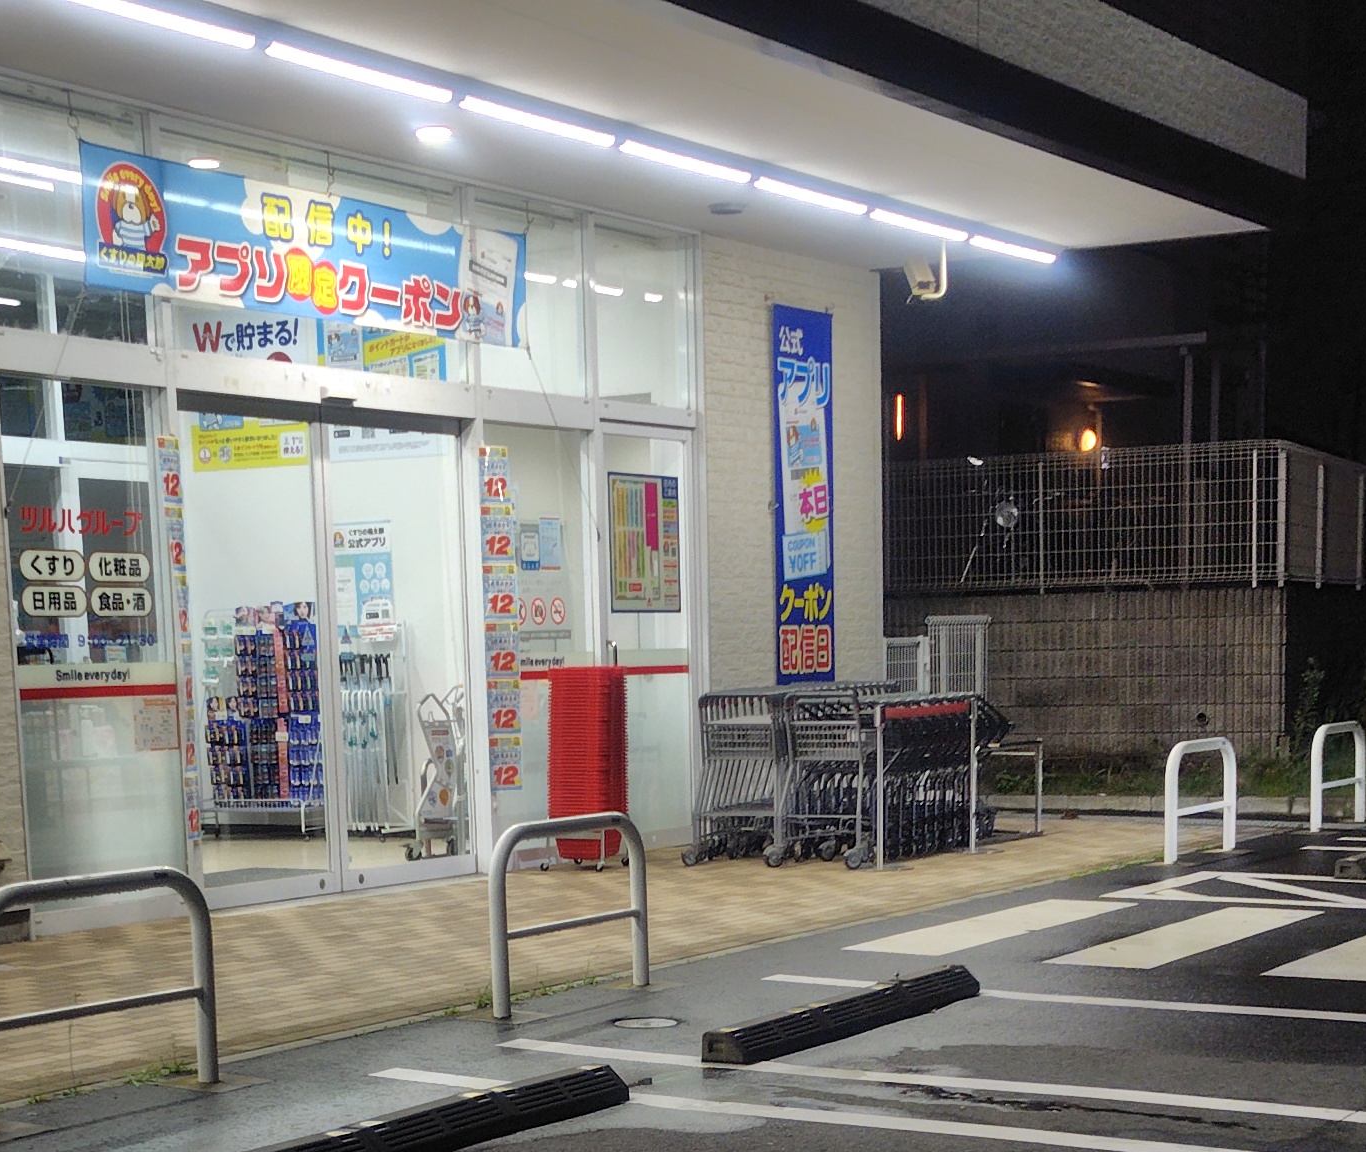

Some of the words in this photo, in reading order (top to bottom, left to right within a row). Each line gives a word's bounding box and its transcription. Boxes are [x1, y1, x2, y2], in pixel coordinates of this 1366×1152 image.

[261, 192, 392, 259] 配信中!
[100, 246, 166, 271] くすりの福太郎
[174, 234, 464, 331] アプリ限定クーポン
[192, 318, 299, 352] Wで貯まる!
[778, 325, 804, 357] 公式
[778, 357, 831, 408] アプリ
[163, 472, 180, 497] 12
[484, 477, 507, 497] 12
[799, 484, 828, 519] 本日
[21, 506, 143, 537] ツルハグループ
[348, 537, 386, 549] 公式アプリ
[486, 535, 511, 556] 12
[787, 536, 815, 551] COUPON
[31, 555, 75, 576] くすり
[98, 557, 142, 578] 化粧品
[32, 591, 77, 611] 日用品
[98, 592, 146, 612] 食品・酒
[488, 594, 514, 614] 12
[780, 582, 832, 623] クーポン
[779, 624, 832, 674] 配信日
[490, 651, 516, 672] 12
[56, 670, 83, 682] Smile
[492, 709, 517, 729] 12
[494, 766, 519, 786] 12
